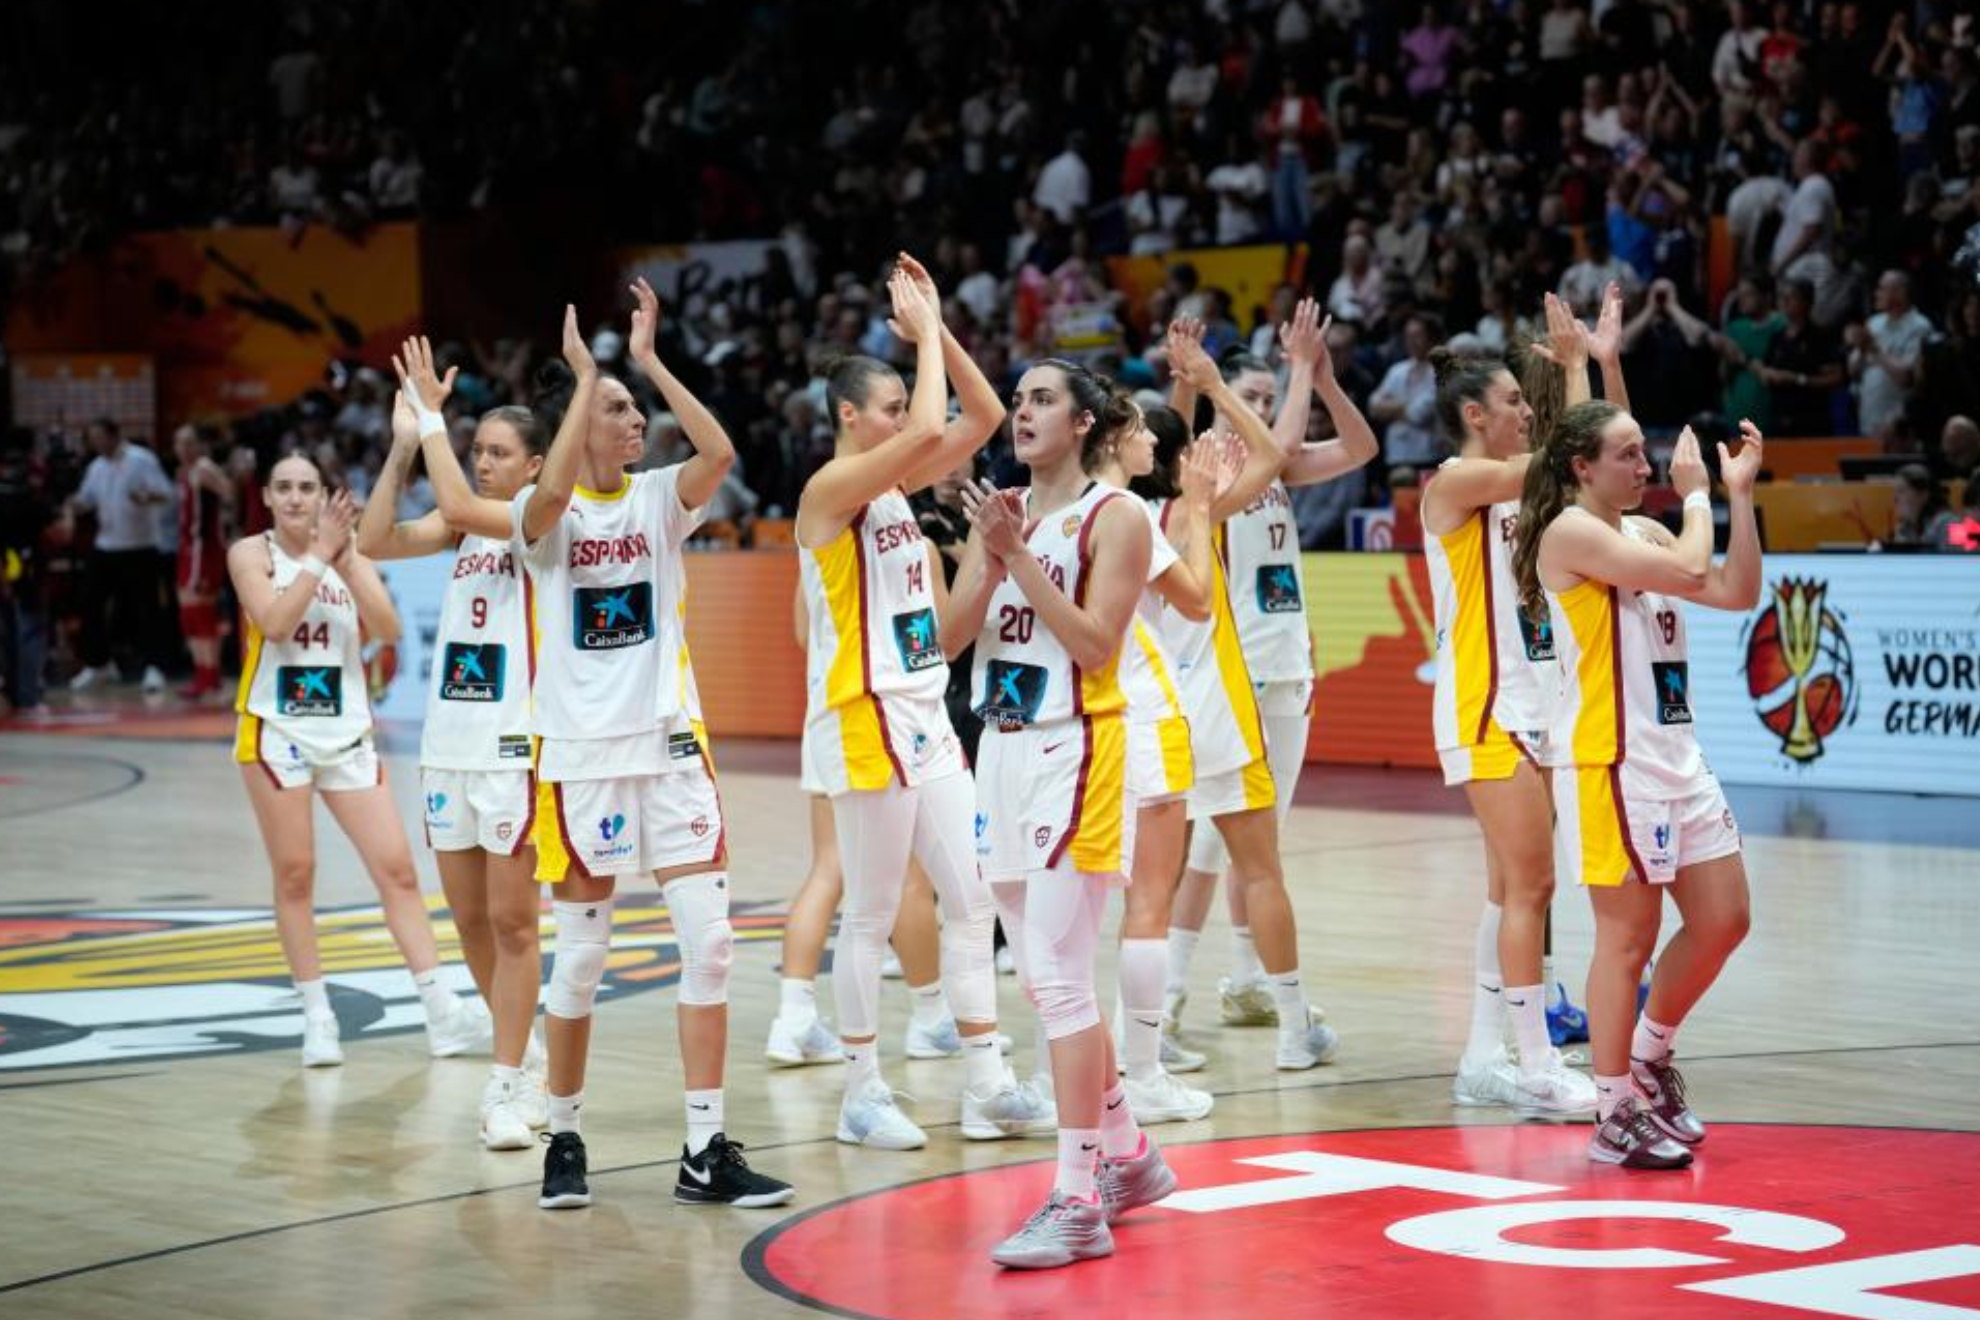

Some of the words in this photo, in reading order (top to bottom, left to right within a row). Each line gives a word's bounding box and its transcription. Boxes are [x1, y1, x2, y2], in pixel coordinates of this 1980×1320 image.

[1267, 522, 1287, 551] 17
[906, 560, 924, 596] 14
[471, 597, 488, 628] 9
[999, 604, 1035, 645] 20
[293, 621, 330, 650] 44
[584, 630, 647, 648] CaixaBank
[1877, 628, 1977, 651] WOMEN'S
[1884, 652, 1980, 690] WOR
